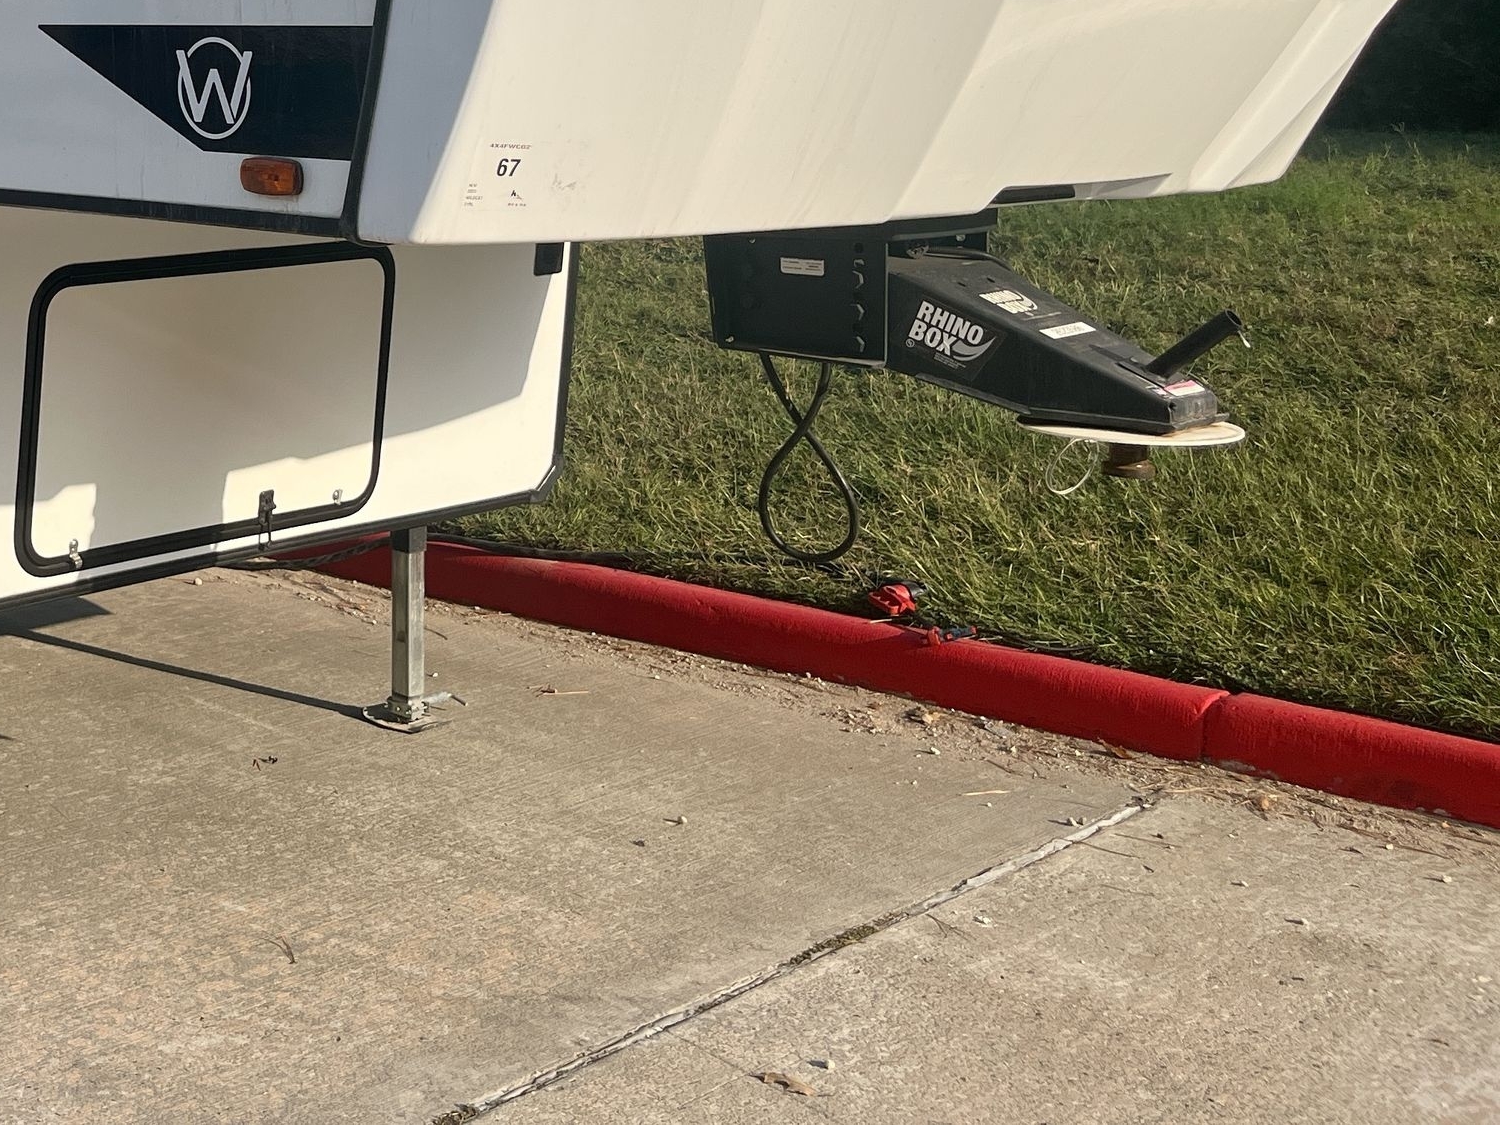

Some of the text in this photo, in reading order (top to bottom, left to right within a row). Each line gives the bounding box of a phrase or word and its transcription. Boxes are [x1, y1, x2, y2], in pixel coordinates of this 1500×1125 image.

[176, 49, 253, 125] W
[496, 158, 522, 177] 67
[908, 319, 957, 356] BOX
[916, 300, 984, 345] RHINO
